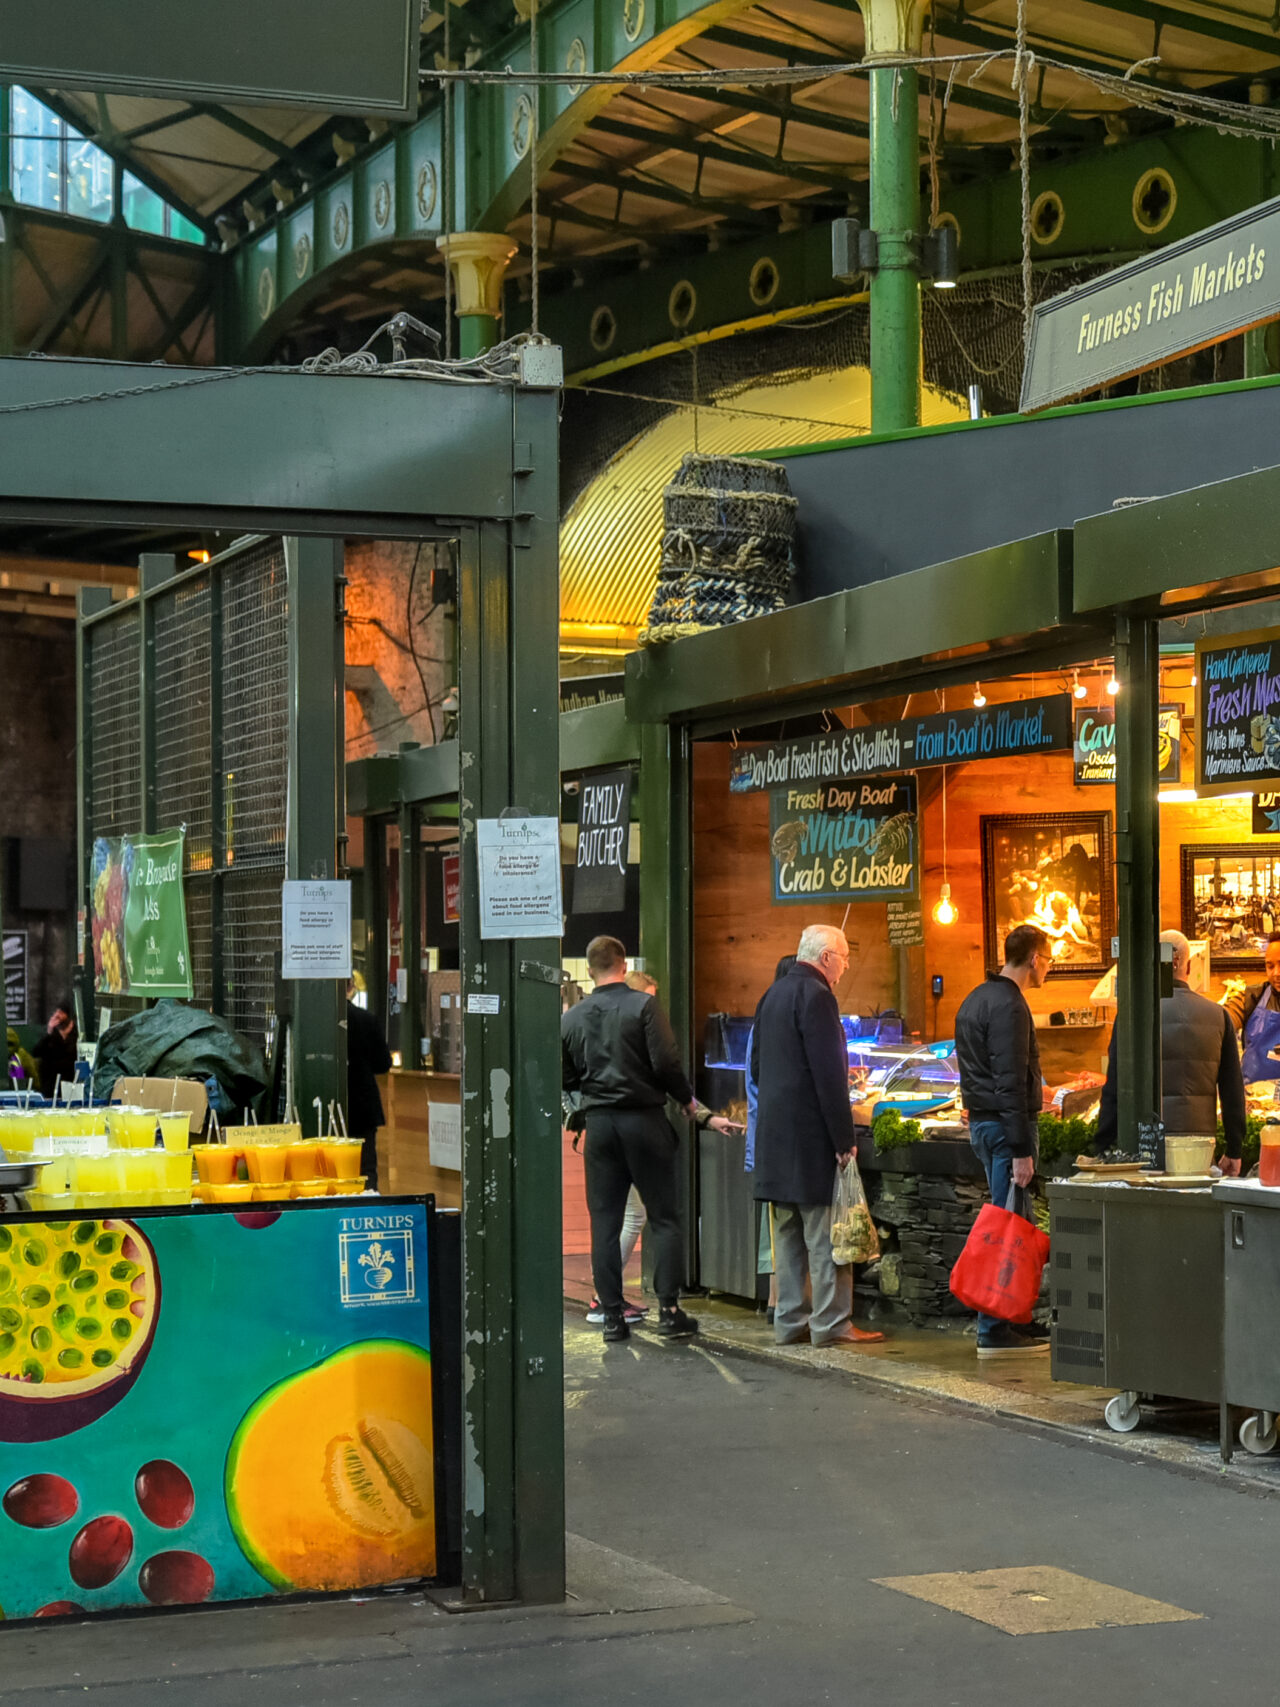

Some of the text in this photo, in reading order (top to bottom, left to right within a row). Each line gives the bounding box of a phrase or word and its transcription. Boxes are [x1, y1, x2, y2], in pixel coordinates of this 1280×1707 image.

[1077, 243, 1266, 354] Furness Fish Markets
[1205, 645, 1271, 683] Hand Gathered
[1207, 682, 1252, 728] Fresh
[750, 753, 767, 789] Day
[767, 747, 789, 783] Boat
[791, 742, 817, 779] Fresh
[817, 740, 838, 776] Fish
[841, 734, 850, 776] &
[852, 728, 900, 772] Shellfish
[915, 723, 944, 760] From
[947, 715, 979, 756] Boat
[981, 713, 993, 752] To
[1207, 726, 1245, 754] White Wine
[582, 783, 624, 825] FAMILY
[787, 782, 897, 812] Fresh Day Boat
[577, 825, 626, 875] BUTCHER
[799, 809, 887, 858] Whitby
[779, 854, 912, 893] Crab & Lobster
[340, 1215, 414, 1231] TURNIPS
